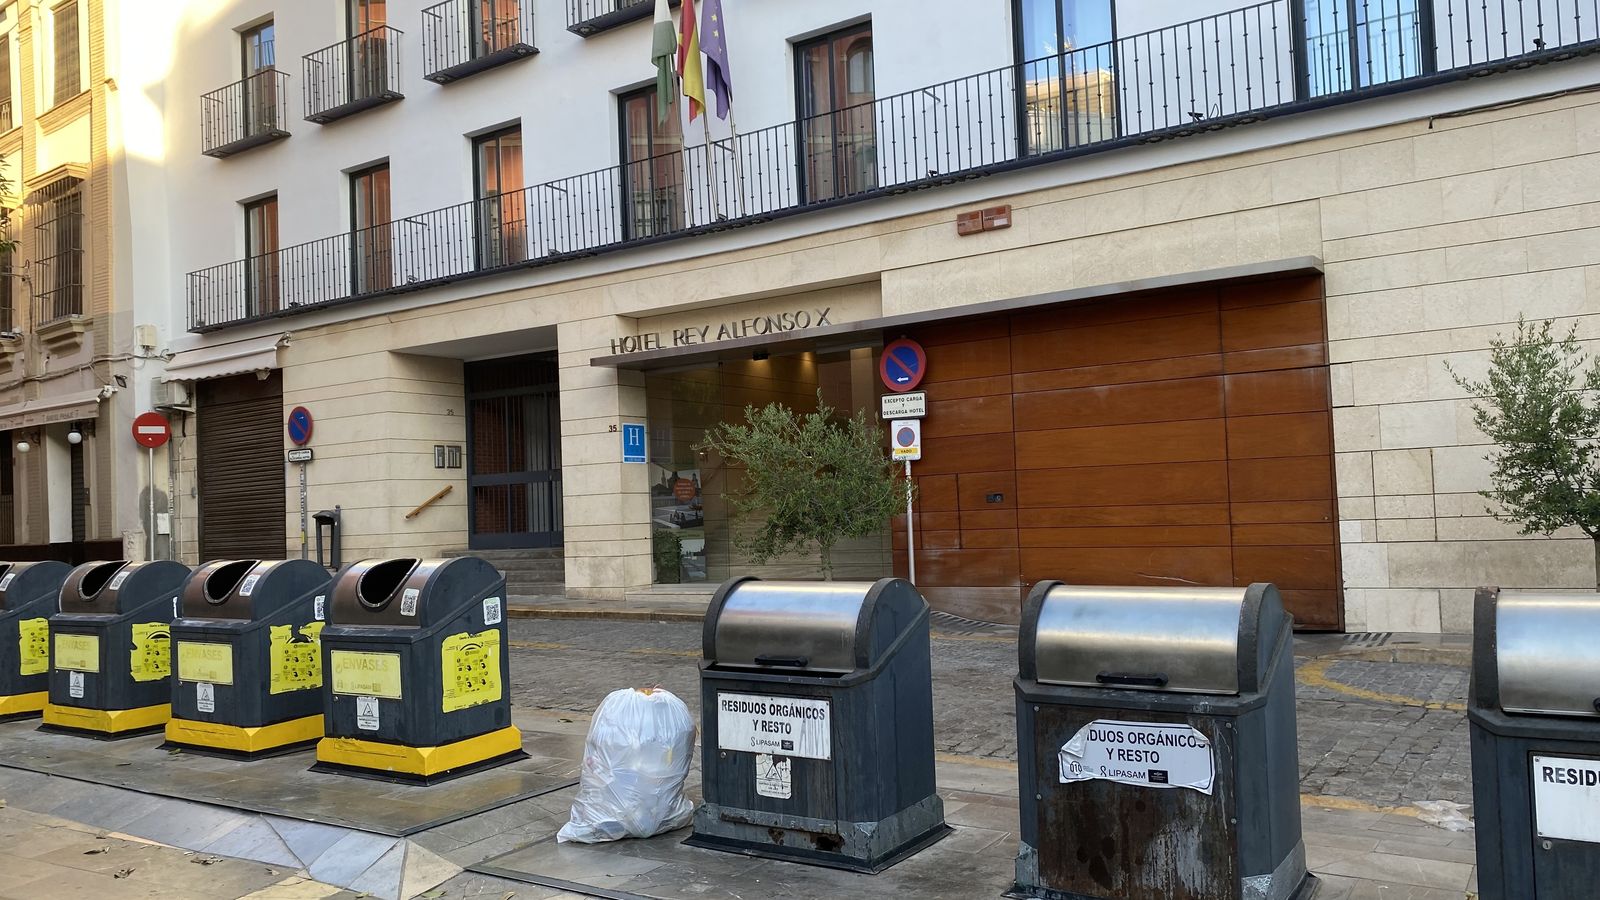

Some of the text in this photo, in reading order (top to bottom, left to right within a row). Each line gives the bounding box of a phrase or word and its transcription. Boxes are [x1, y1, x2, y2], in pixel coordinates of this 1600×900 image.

[610, 307, 831, 355] HOTEL REY ALFONSO X
[608, 424, 618, 433] 35
[628, 427, 640, 446] H
[343, 657, 389, 672] ENVASES
[721, 699, 825, 721] RESIDUOS ORGÁNICOS
[752, 719, 792, 735] Y RESTO
[756, 739, 780, 747] LIPASAM
[1106, 747, 1160, 764] Y RESTO
[1108, 769, 1146, 779] LIPASAM
[1542, 765, 1600, 787] RESID
